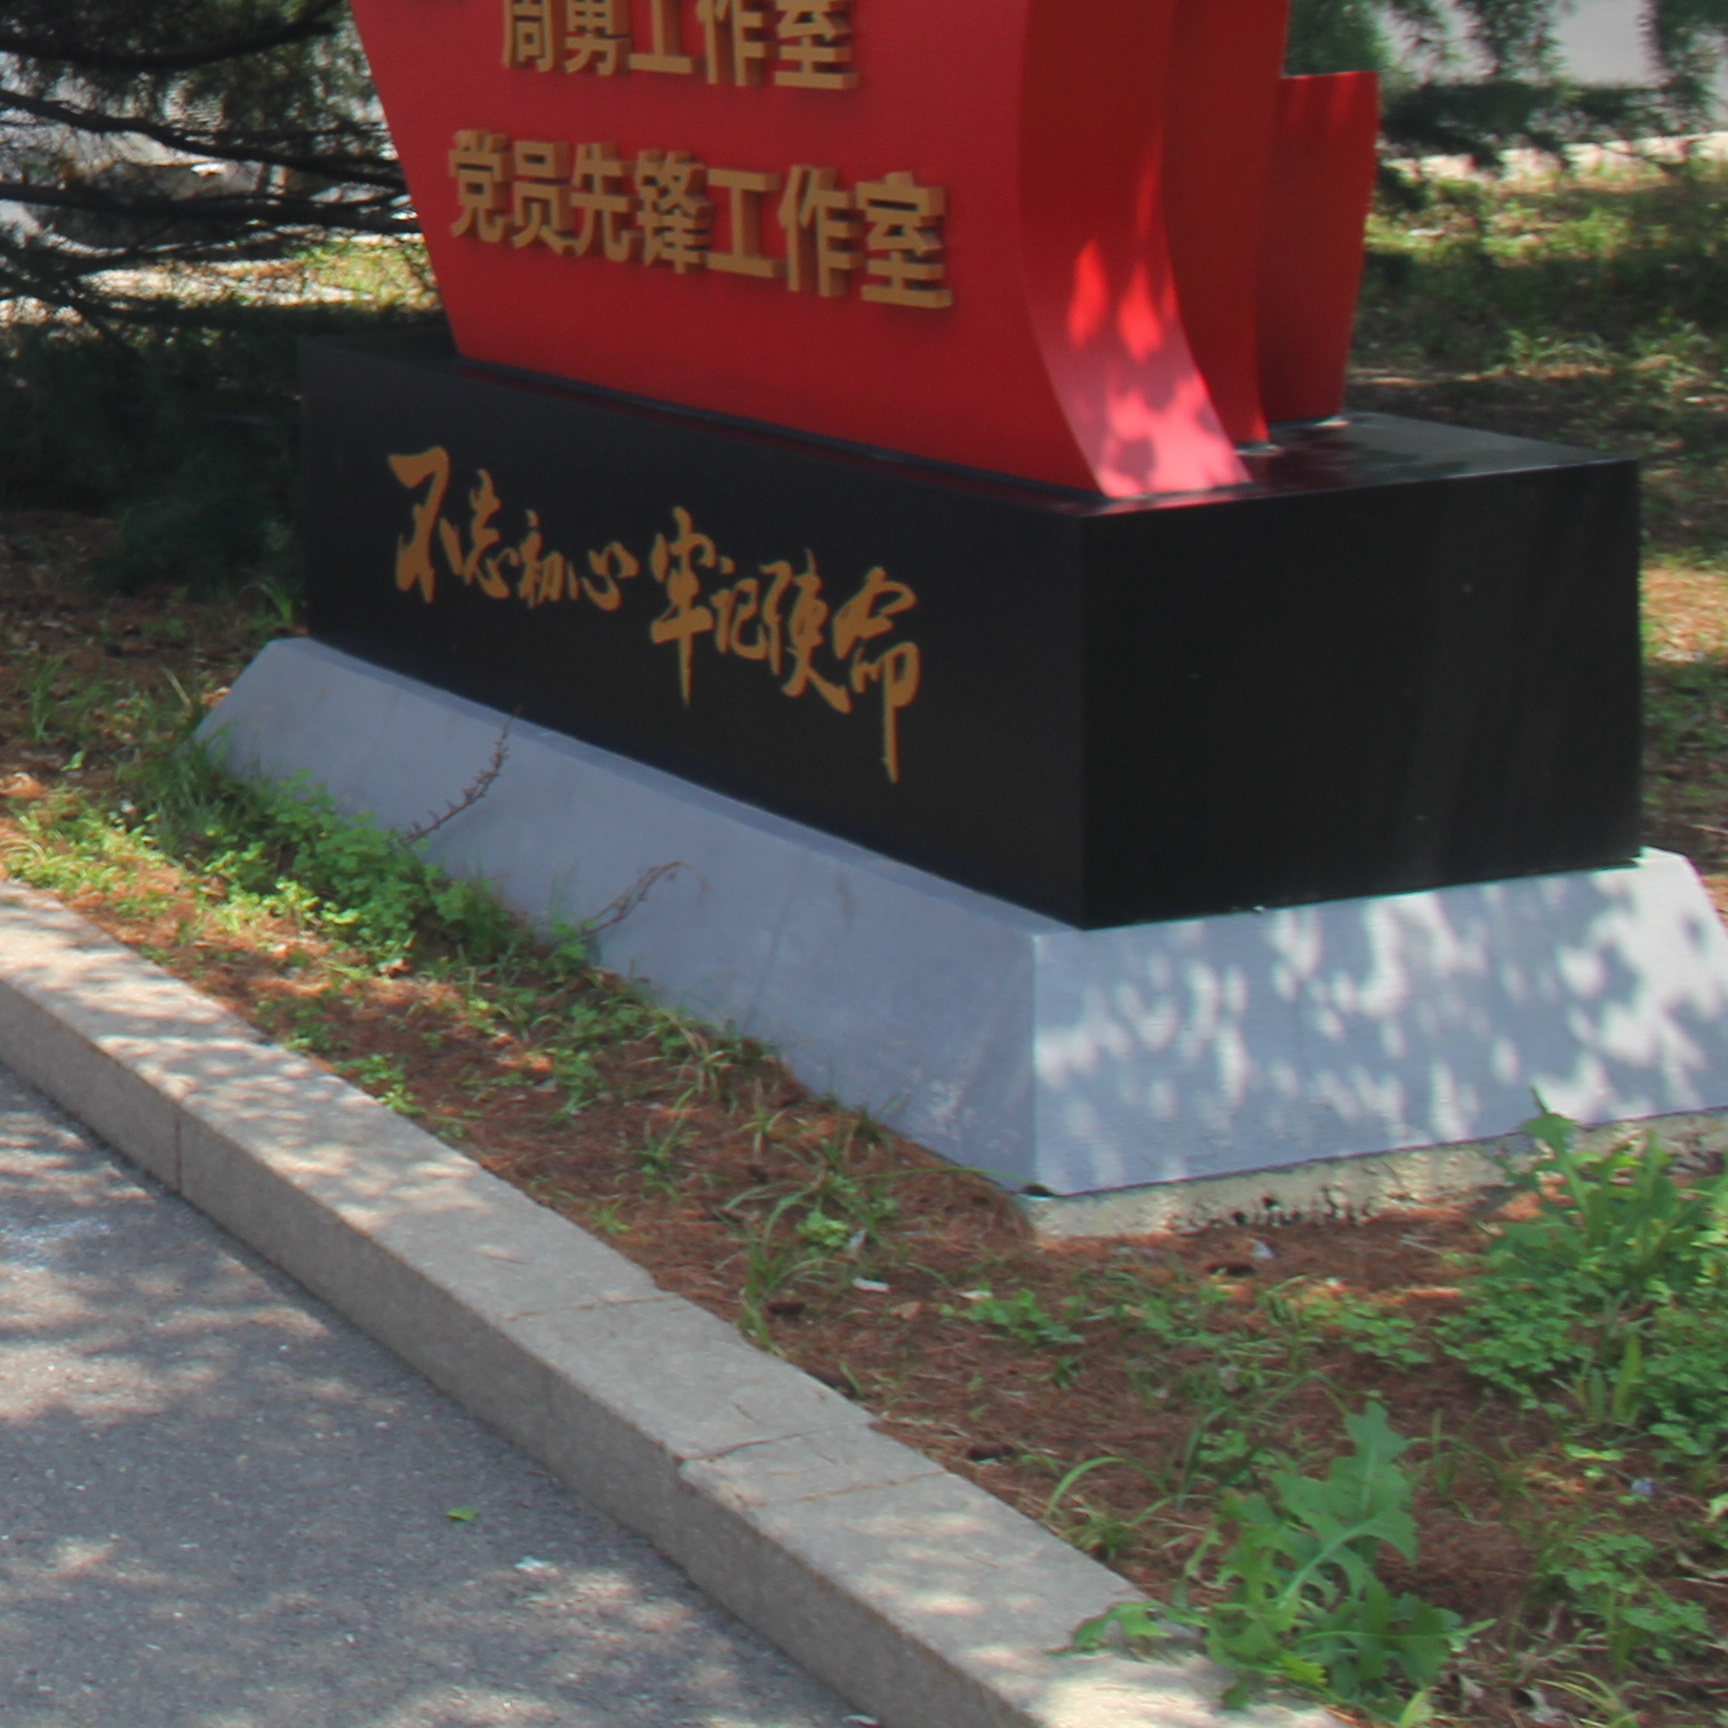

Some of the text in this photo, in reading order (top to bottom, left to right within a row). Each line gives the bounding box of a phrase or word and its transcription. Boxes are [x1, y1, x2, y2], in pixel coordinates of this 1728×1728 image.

[447, 128, 953, 311] 党员先锋工作室
